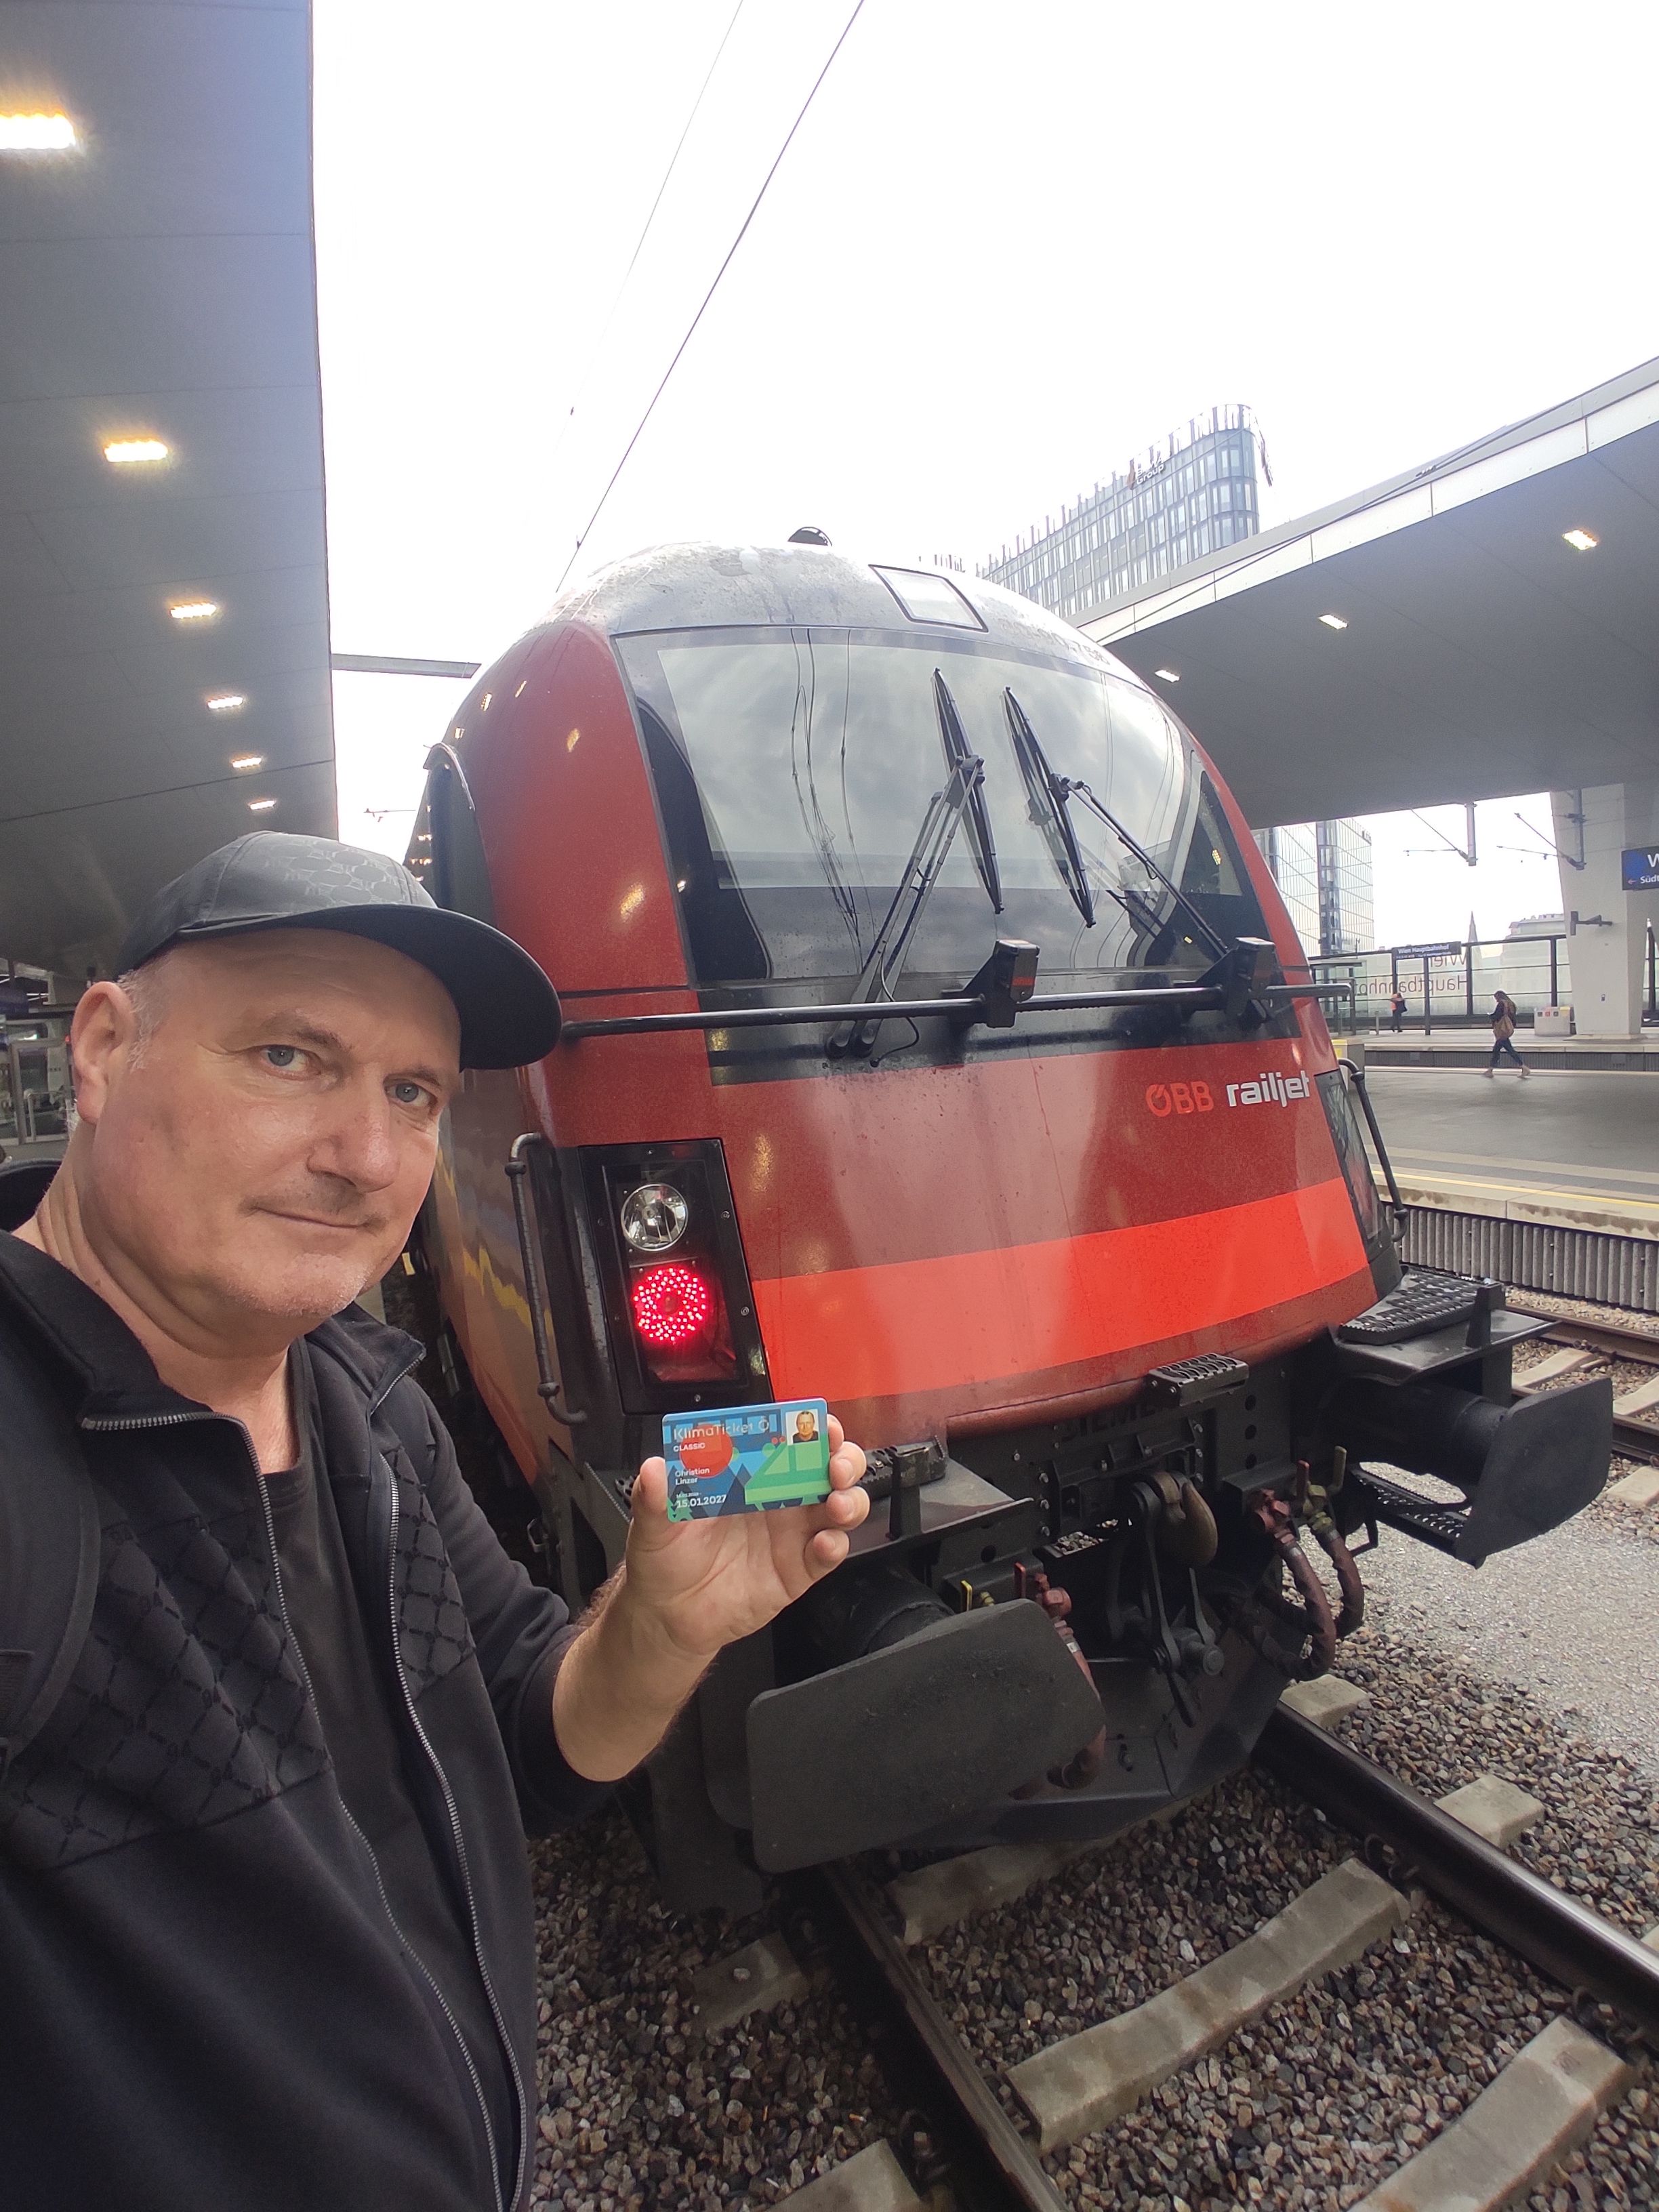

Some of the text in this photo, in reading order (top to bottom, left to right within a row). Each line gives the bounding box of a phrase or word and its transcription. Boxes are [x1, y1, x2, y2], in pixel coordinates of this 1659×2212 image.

[1136, 464, 1164, 485] Group
[1145, 1070, 1311, 1117] ÖBB railjet
[674, 1416, 769, 1441] KlimaTicket Ö
[673, 1442, 705, 1452] CLASSIC
[675, 1467, 710, 1477] Christian
[675, 1477, 698, 1486] Linzer
